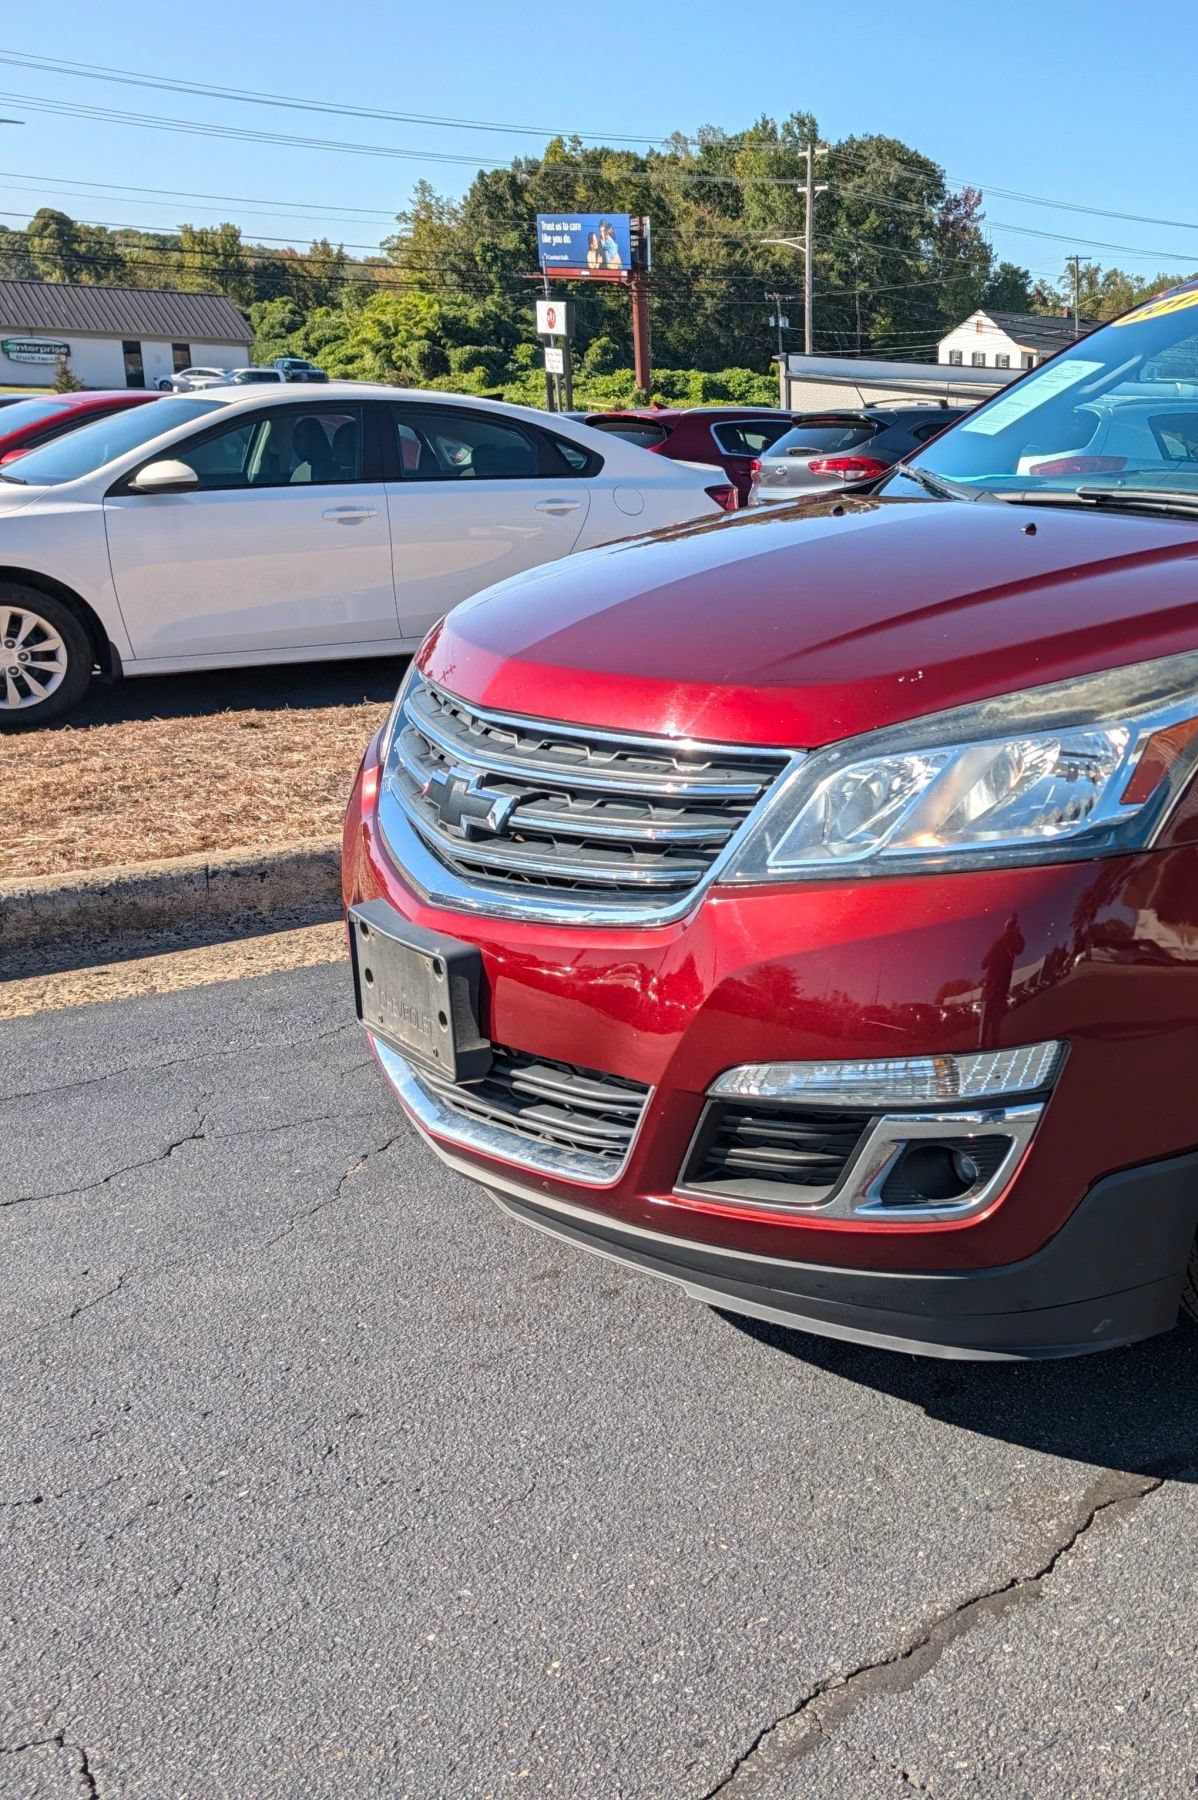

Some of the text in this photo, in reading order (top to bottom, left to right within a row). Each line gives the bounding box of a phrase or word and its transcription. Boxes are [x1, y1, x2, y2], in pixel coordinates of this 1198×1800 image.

[541, 221, 581, 231] Trust us to care
[541, 233, 552, 243] like
[552, 234, 563, 246] you
[4, 343, 68, 353] enterprise
